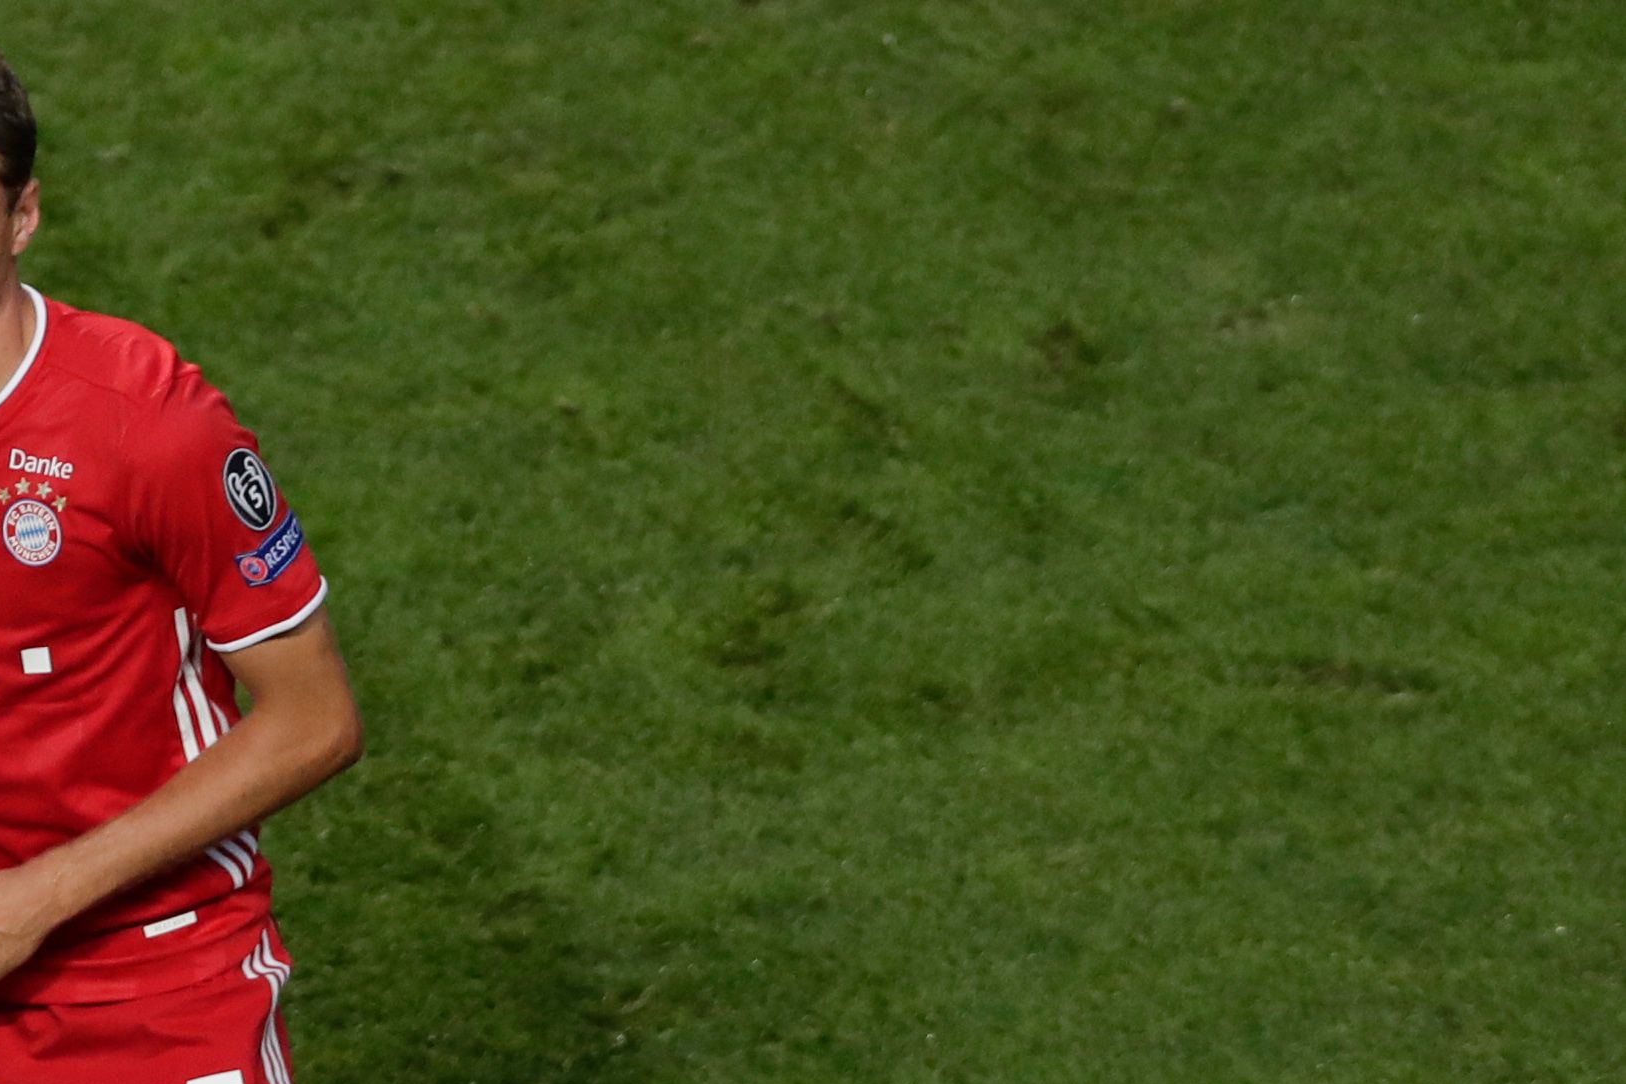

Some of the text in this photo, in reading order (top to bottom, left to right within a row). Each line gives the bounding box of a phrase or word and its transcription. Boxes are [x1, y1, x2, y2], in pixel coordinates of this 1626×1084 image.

[9, 448, 74, 479] Danke
[248, 486, 263, 509] 5
[18, 504, 56, 530] BAYERN
[264, 518, 300, 568] RESPEC
